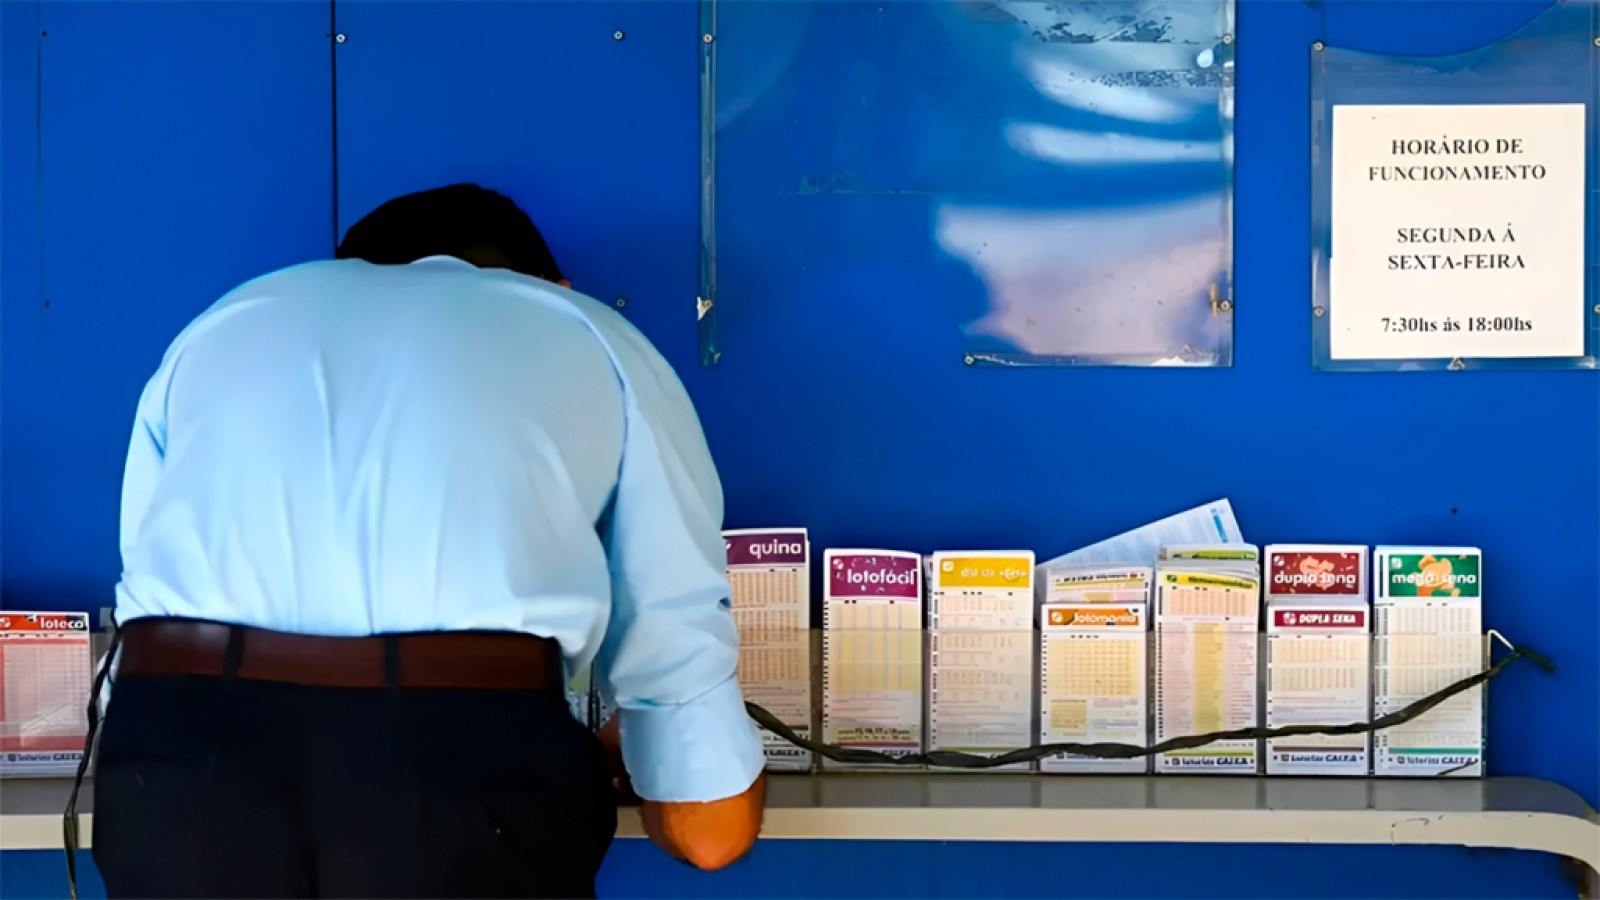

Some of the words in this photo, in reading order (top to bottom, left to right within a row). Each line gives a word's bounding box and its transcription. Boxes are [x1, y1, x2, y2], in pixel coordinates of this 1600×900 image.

[1391, 135, 1490, 155] HORÁRIO
[1496, 138, 1523, 154] DE
[1369, 165, 1546, 181] FUNCIONAMENTO
[1397, 227, 1496, 243] SEGUNDA
[1388, 254, 1526, 270] SEXTA-FEIRA
[1381, 317, 1438, 332] 7:30hs
[1468, 316, 1533, 332] 18:00hs
[749, 538, 802, 560] quina
[846, 568, 916, 585] lotofácil
[40, 617, 84, 629] loteca
